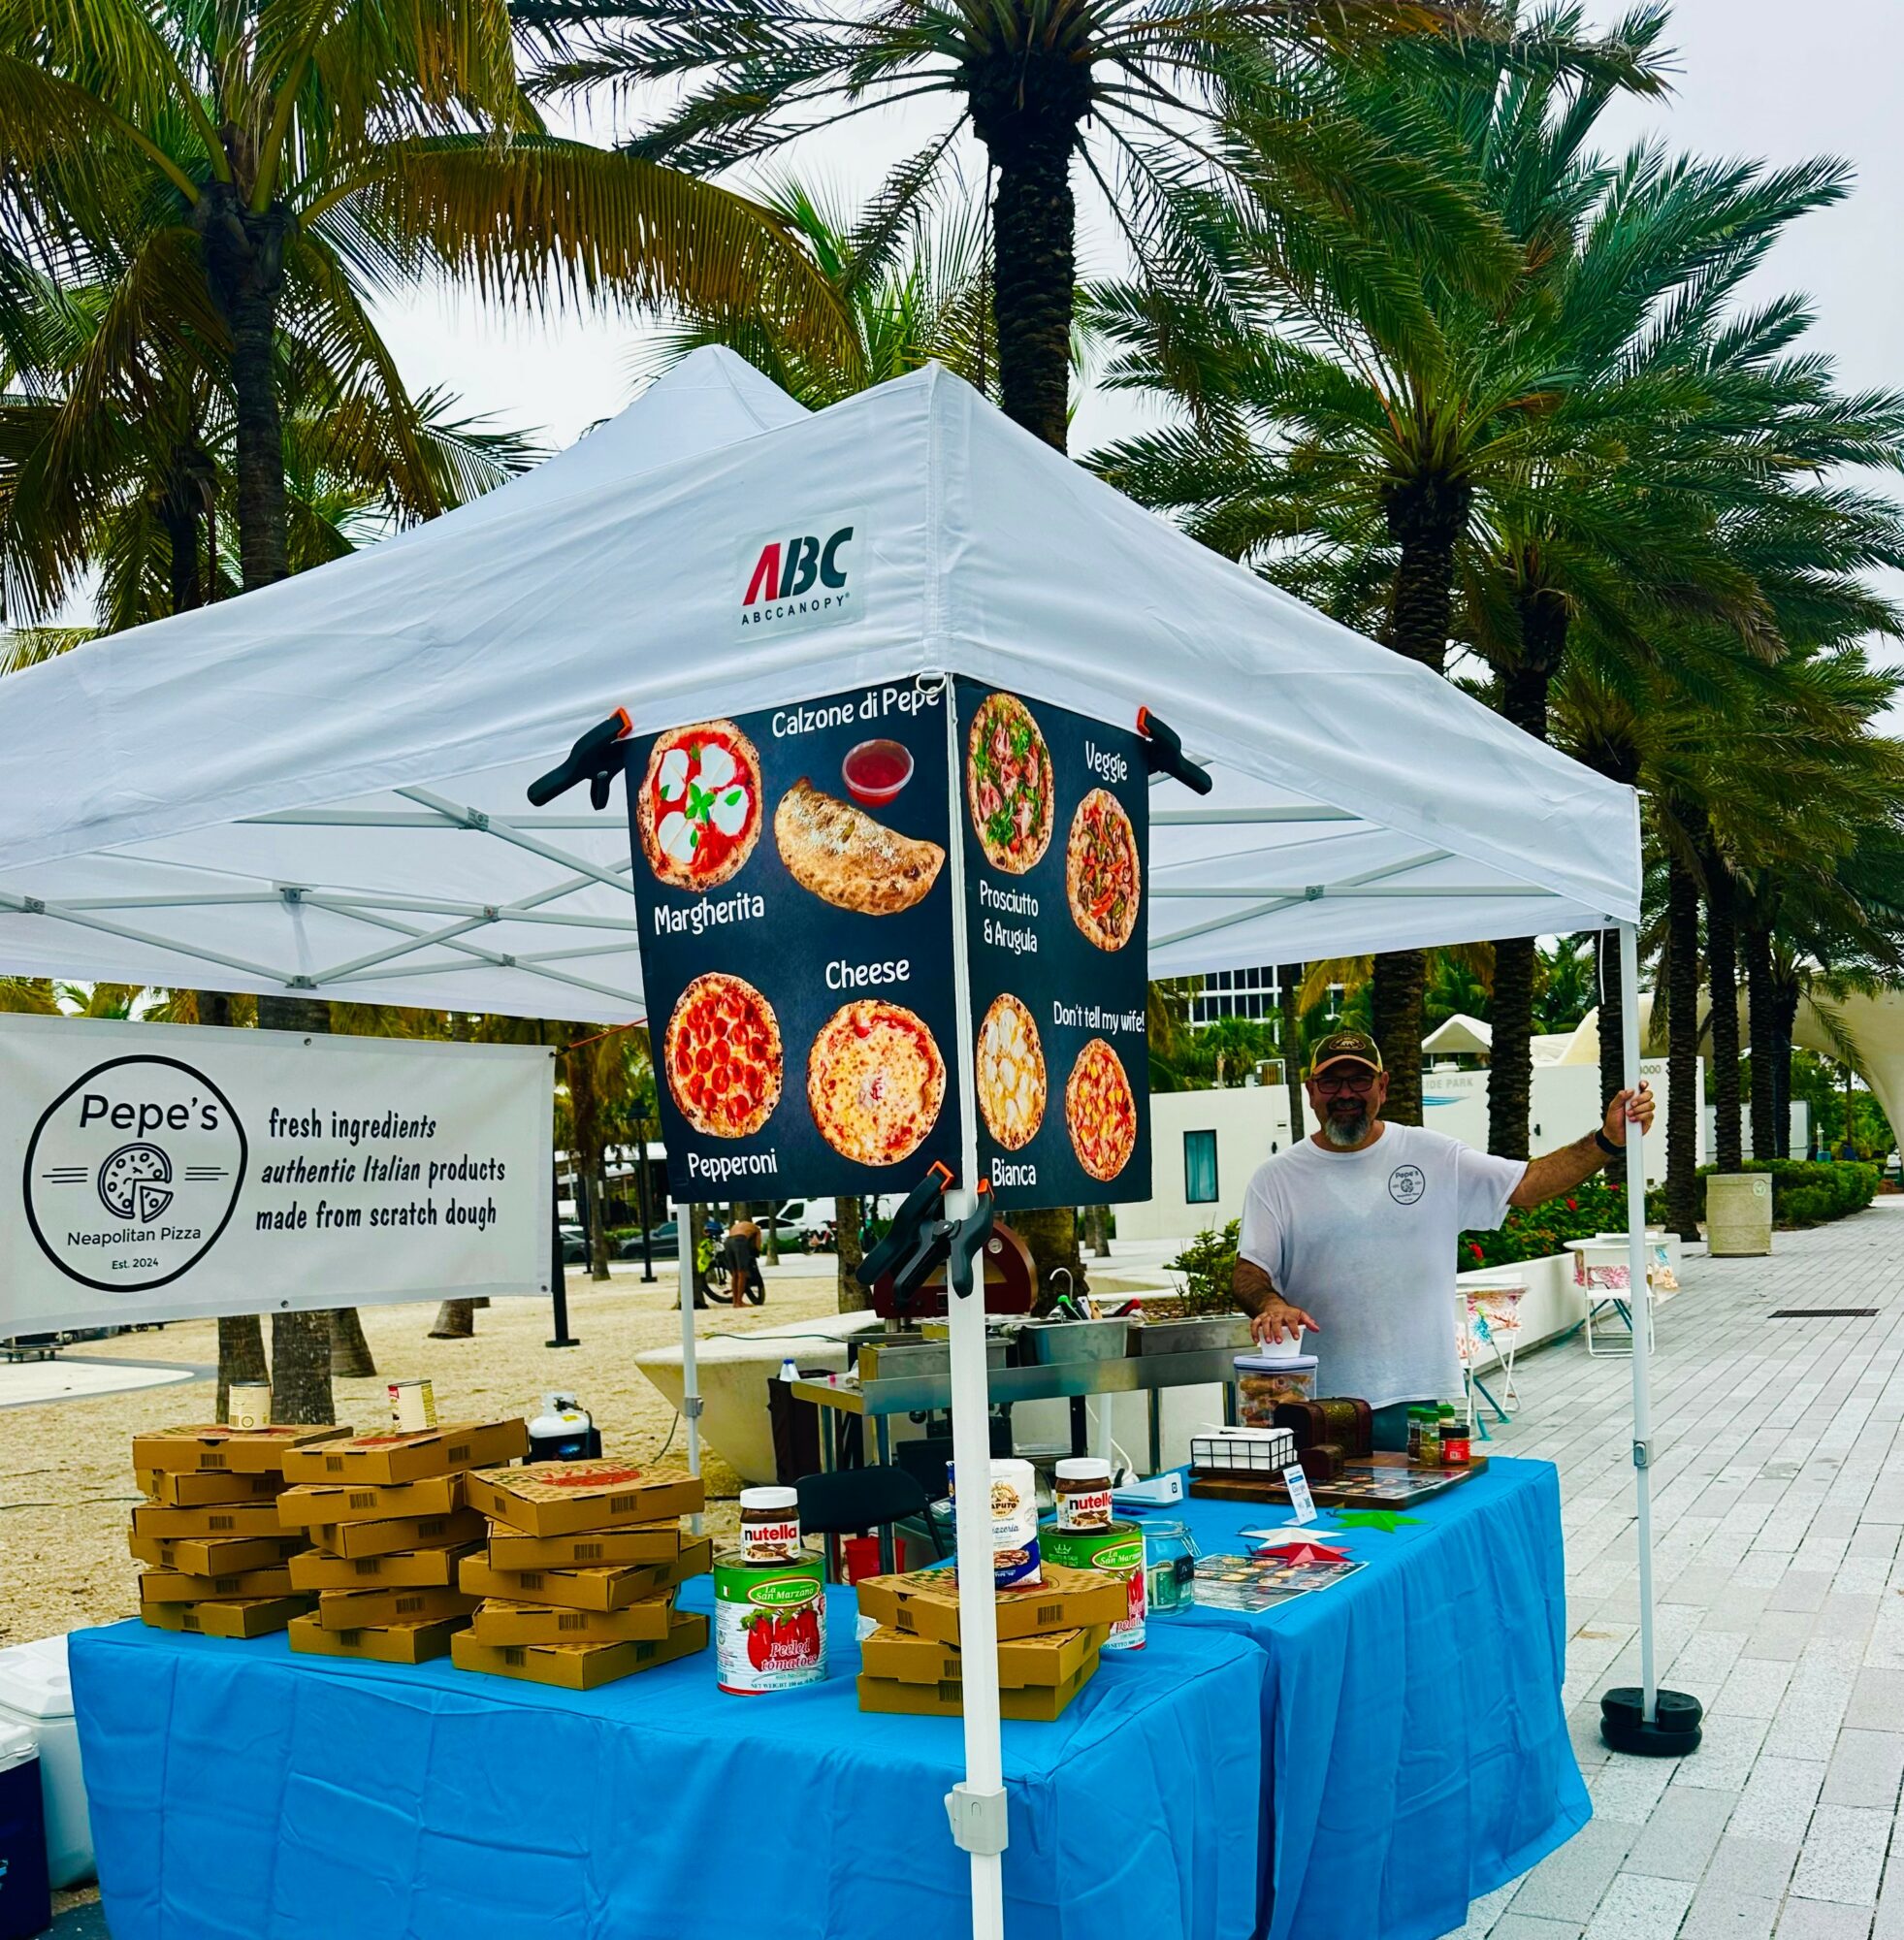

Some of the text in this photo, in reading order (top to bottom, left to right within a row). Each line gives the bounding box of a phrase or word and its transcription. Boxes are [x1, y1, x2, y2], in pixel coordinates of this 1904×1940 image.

[742, 526, 855, 607] ABC
[772, 686, 940, 738] Calzone di Pepe
[1085, 741, 1128, 784] Veggie
[654, 891, 765, 935] Margherita
[980, 880, 1039, 917] Prosciutto
[984, 919, 1038, 955] & Arugula
[825, 958, 911, 989] Cheese
[1053, 1001, 1146, 1035] Don't tell my wife!
[1445, 1077, 1474, 1089] PARK
[1640, 1064, 1662, 1075] 000
[80, 1093, 219, 1138] Pepe's
[269, 1107, 437, 1147] fresh ingredients
[261, 1153, 506, 1189] authentic Italian products
[687, 1148, 778, 1182] Pepperoni
[991, 1157, 1037, 1187] Bianca
[255, 1196, 497, 1232] made from scratch dough
[67, 1226, 202, 1247] Neapolitan Pizza
[112, 1257, 159, 1270] Est. 2024
[991, 1502, 1017, 1510] APUTO
[744, 1524, 797, 1541] nutella
[756, 1586, 815, 1601] San Marzano
[765, 1585, 777, 1594] La
[760, 1653, 818, 1671] tomatoes
[769, 1636, 811, 1658] Peeled
